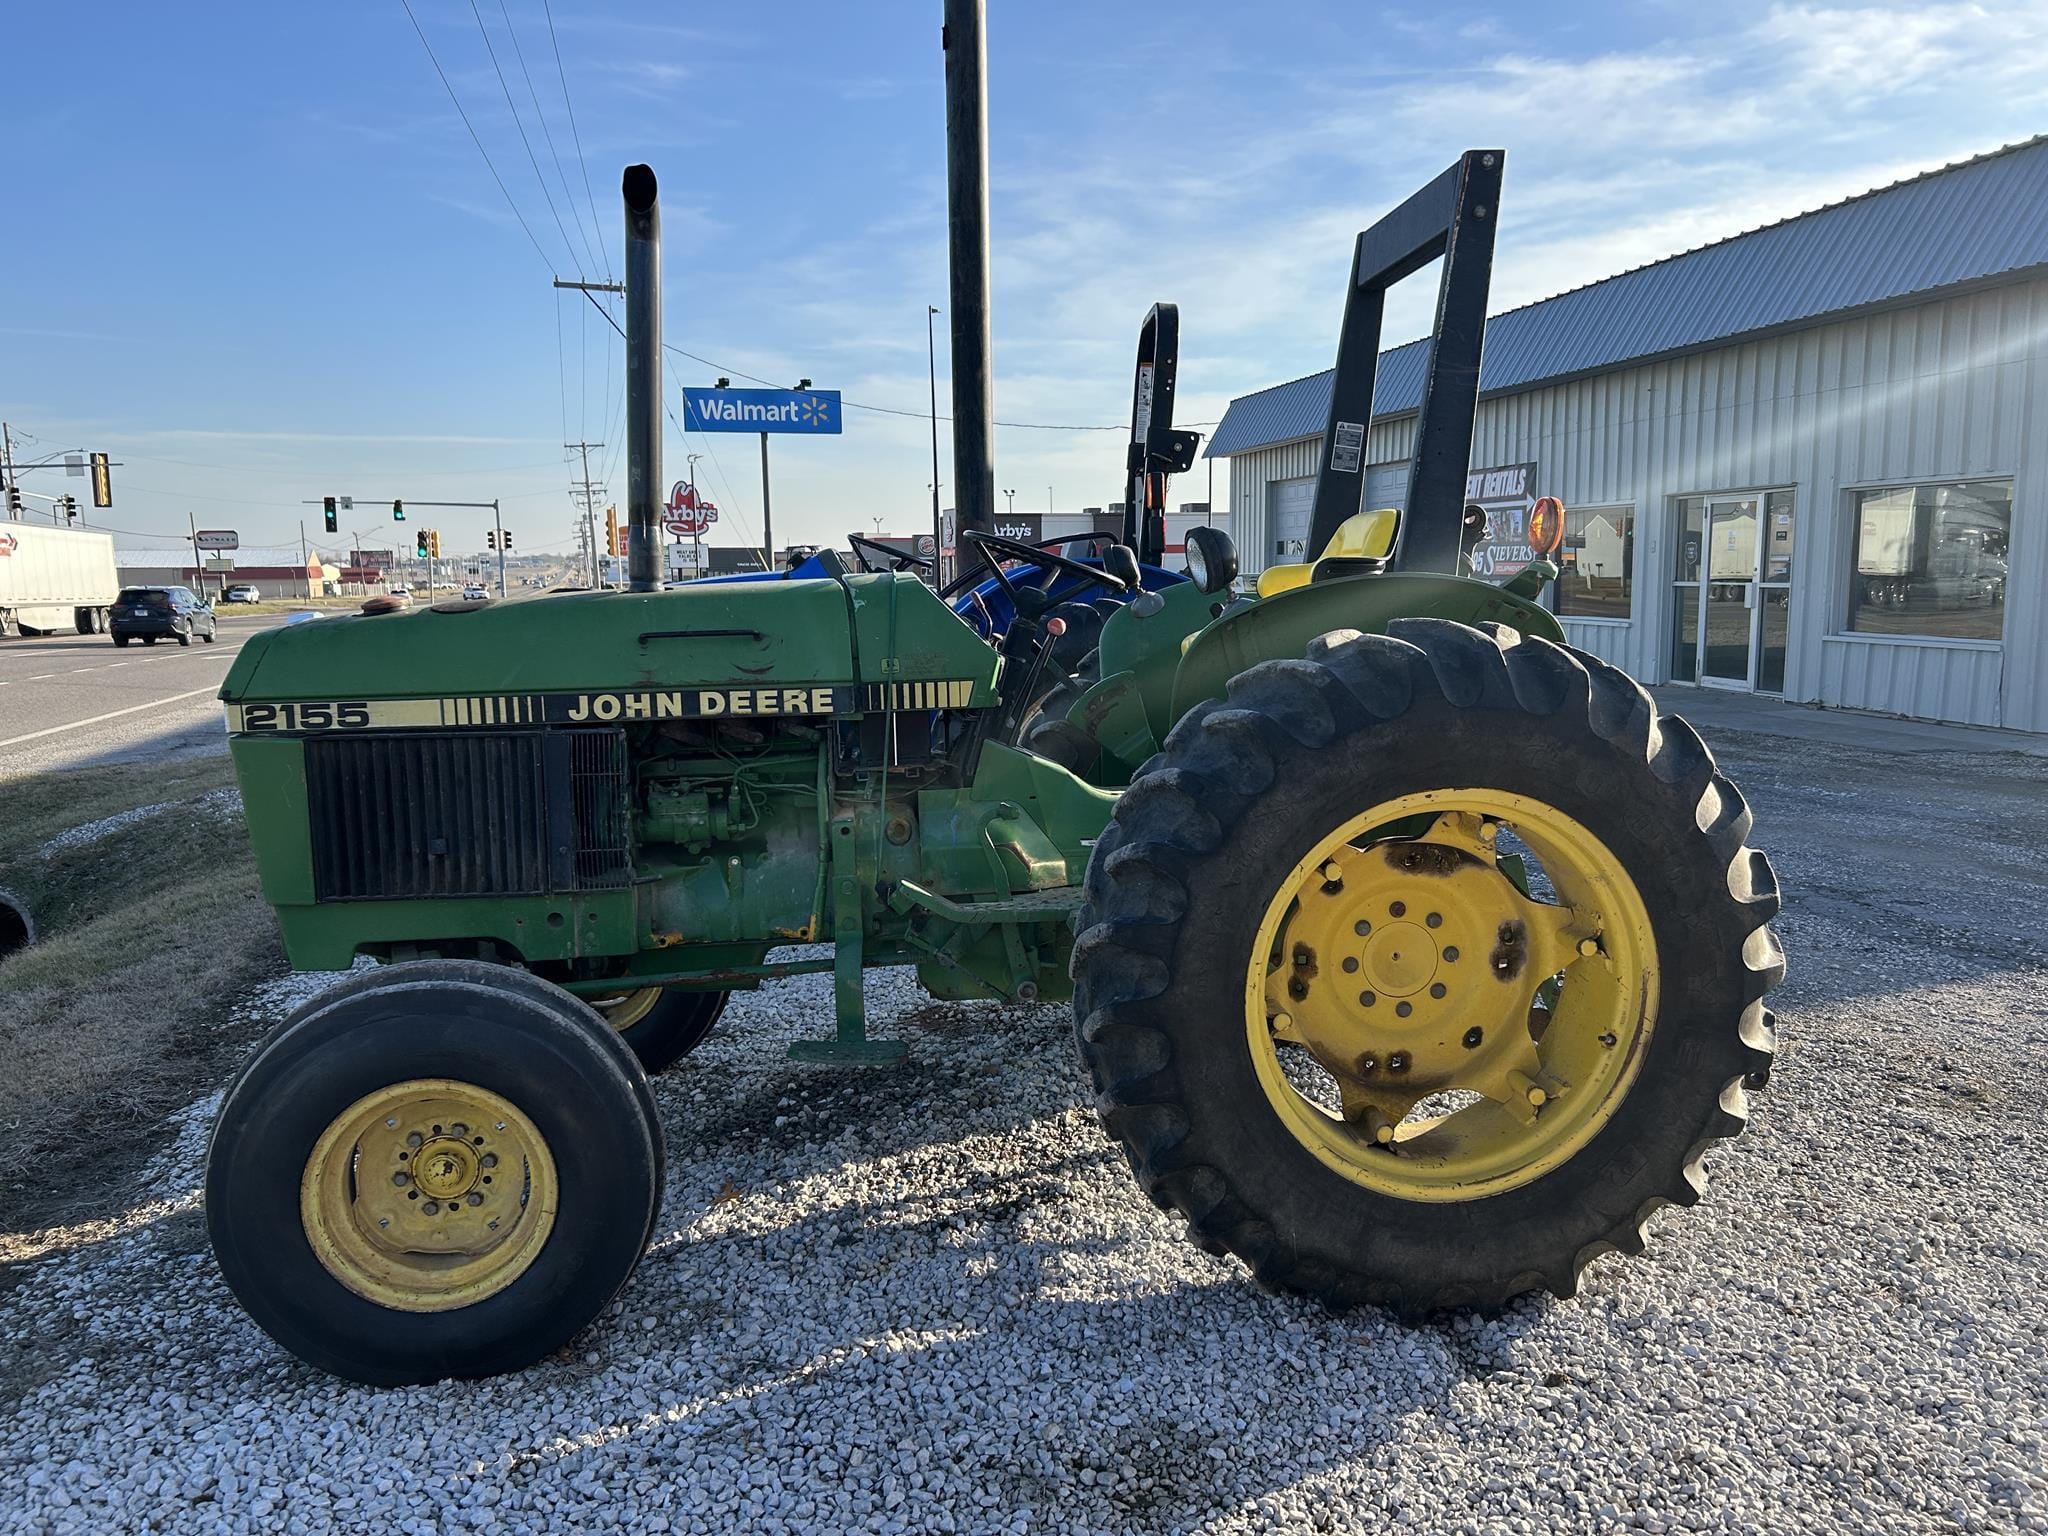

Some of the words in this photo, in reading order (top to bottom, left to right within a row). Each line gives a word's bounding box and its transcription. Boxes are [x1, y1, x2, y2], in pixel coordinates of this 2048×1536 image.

[699, 399, 799, 422] Walmart
[1482, 468, 1527, 498] RENTALS
[662, 503, 717, 525] Arby's
[1483, 545, 1533, 576] SIEVERS
[245, 702, 370, 730] 2155
[568, 692, 683, 721] JOHN
[699, 689, 834, 716] DEERE
